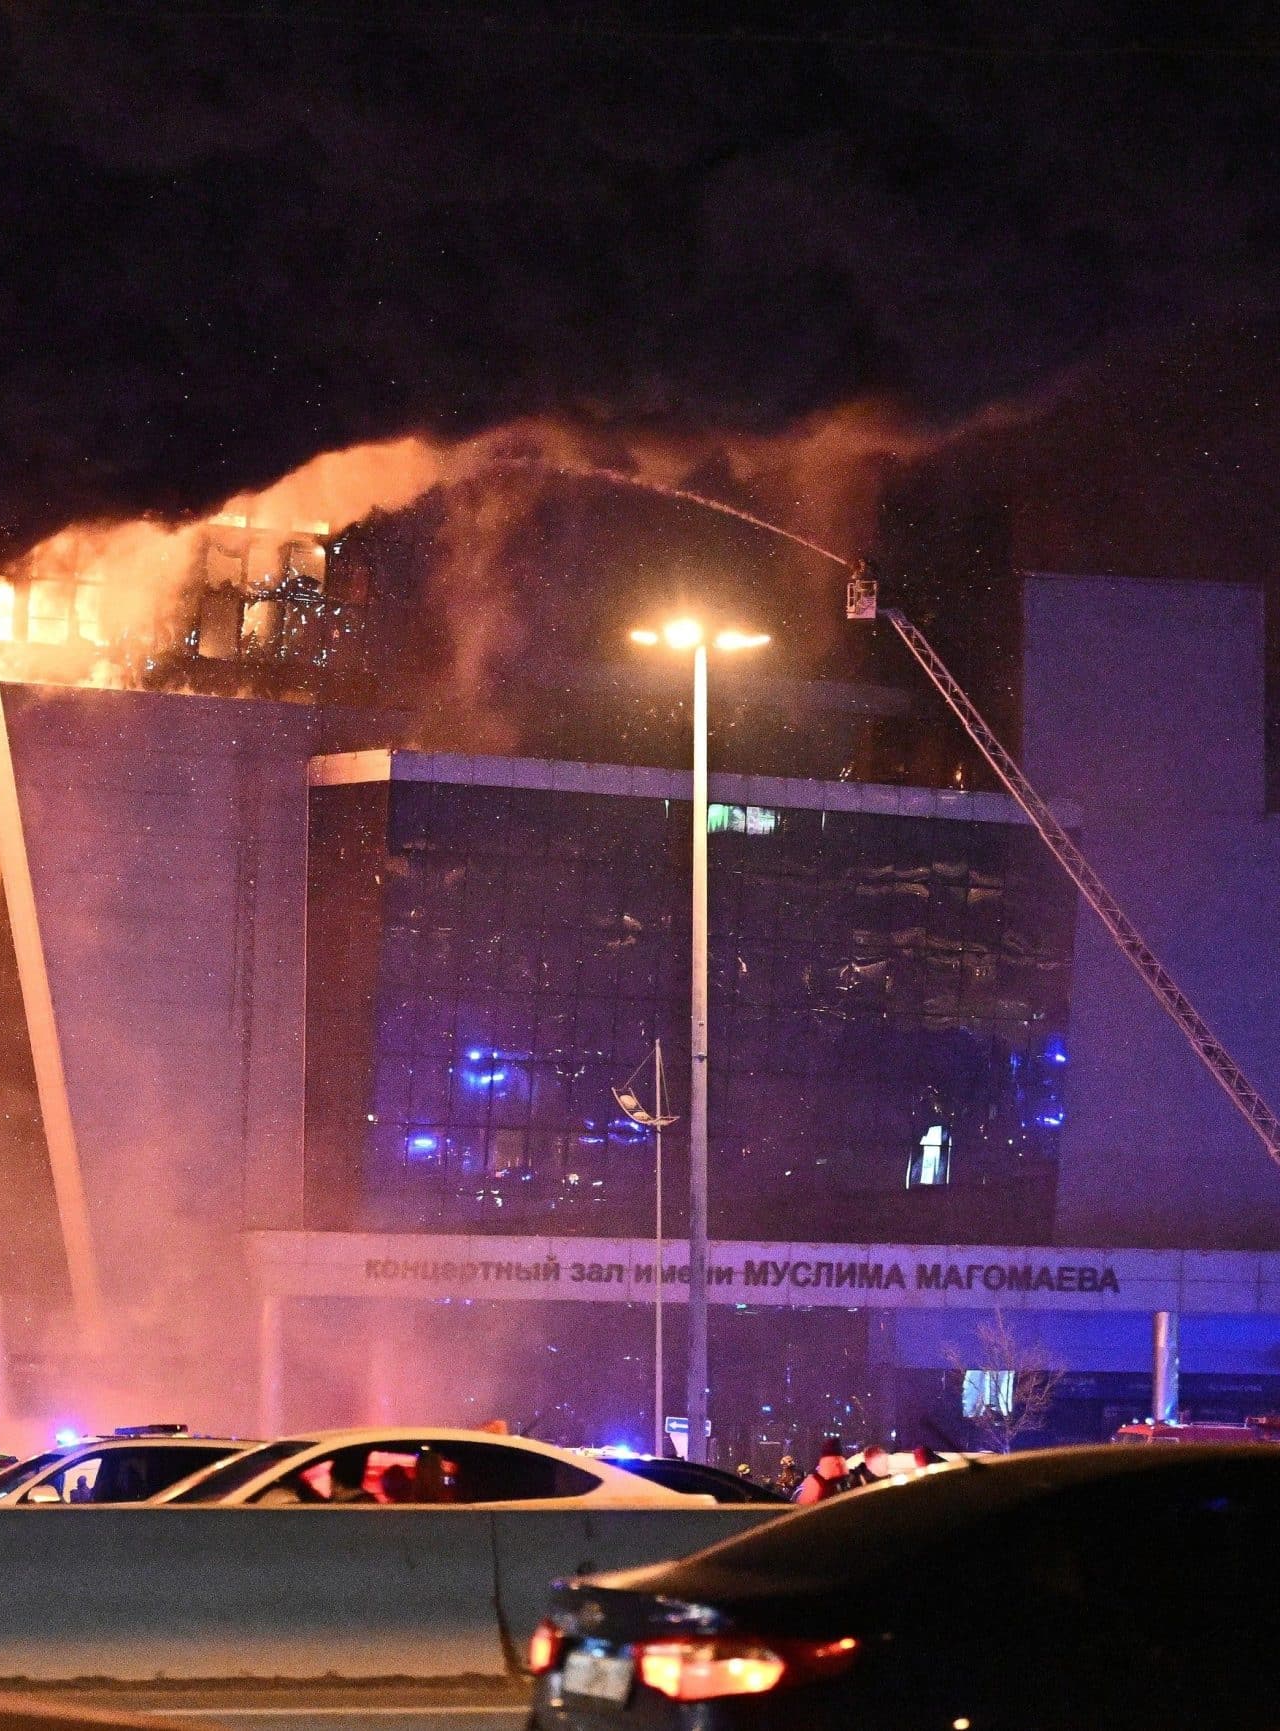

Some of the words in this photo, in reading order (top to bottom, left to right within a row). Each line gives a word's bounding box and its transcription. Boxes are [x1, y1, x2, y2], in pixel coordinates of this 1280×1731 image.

[570, 1262, 624, 1284] зал
[743, 1259, 907, 1290] МУСЛИМА
[919, 1262, 1120, 1294] МАГОМАЕВА
